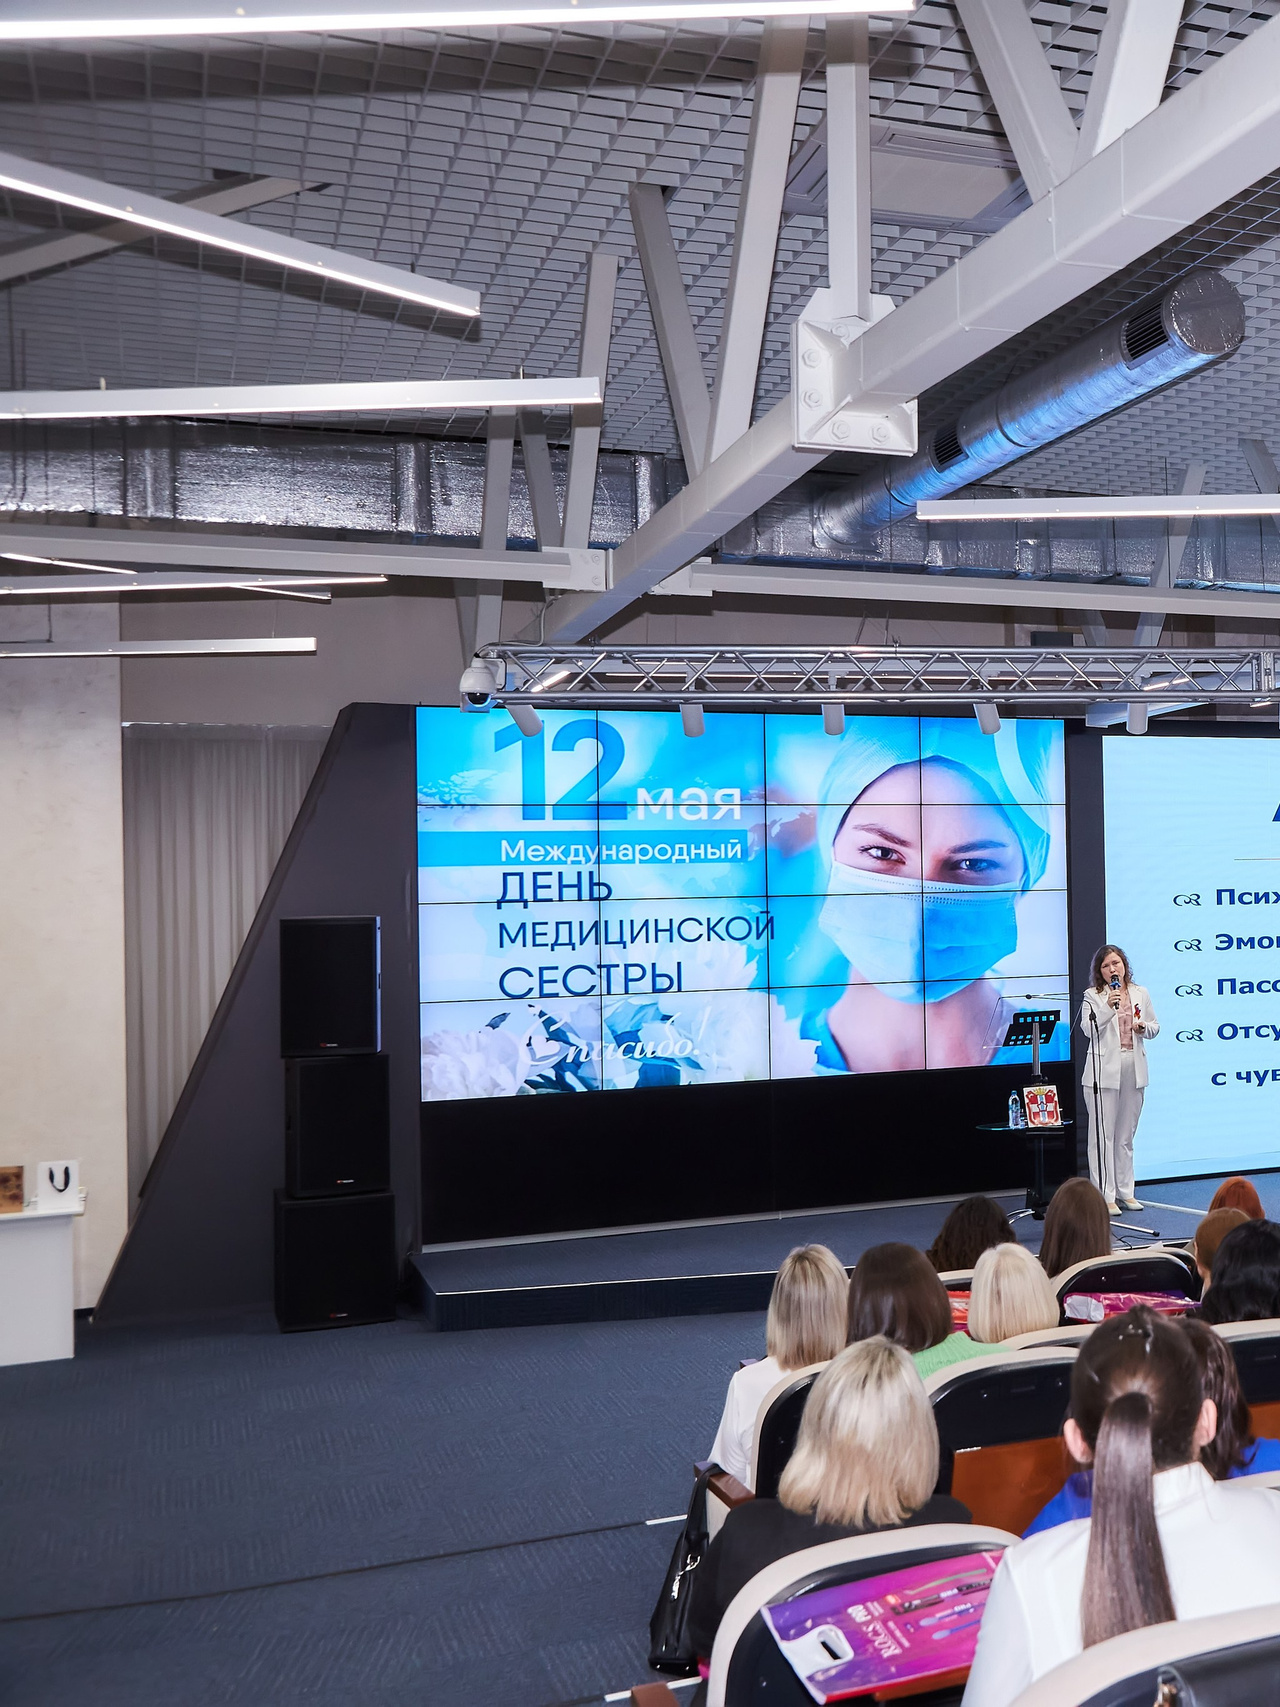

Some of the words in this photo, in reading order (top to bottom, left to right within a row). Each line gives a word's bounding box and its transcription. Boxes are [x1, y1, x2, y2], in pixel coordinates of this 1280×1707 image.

[494, 718, 628, 820] 12
[636, 787, 741, 820] мая
[501, 838, 741, 865] Международный
[496, 870, 613, 909] ДЕНЬ
[499, 911, 775, 951] МЕДИЦИНСКОЙ
[499, 961, 682, 999] СЕСТРЫ
[1211, 1071, 1227, 1086] с
